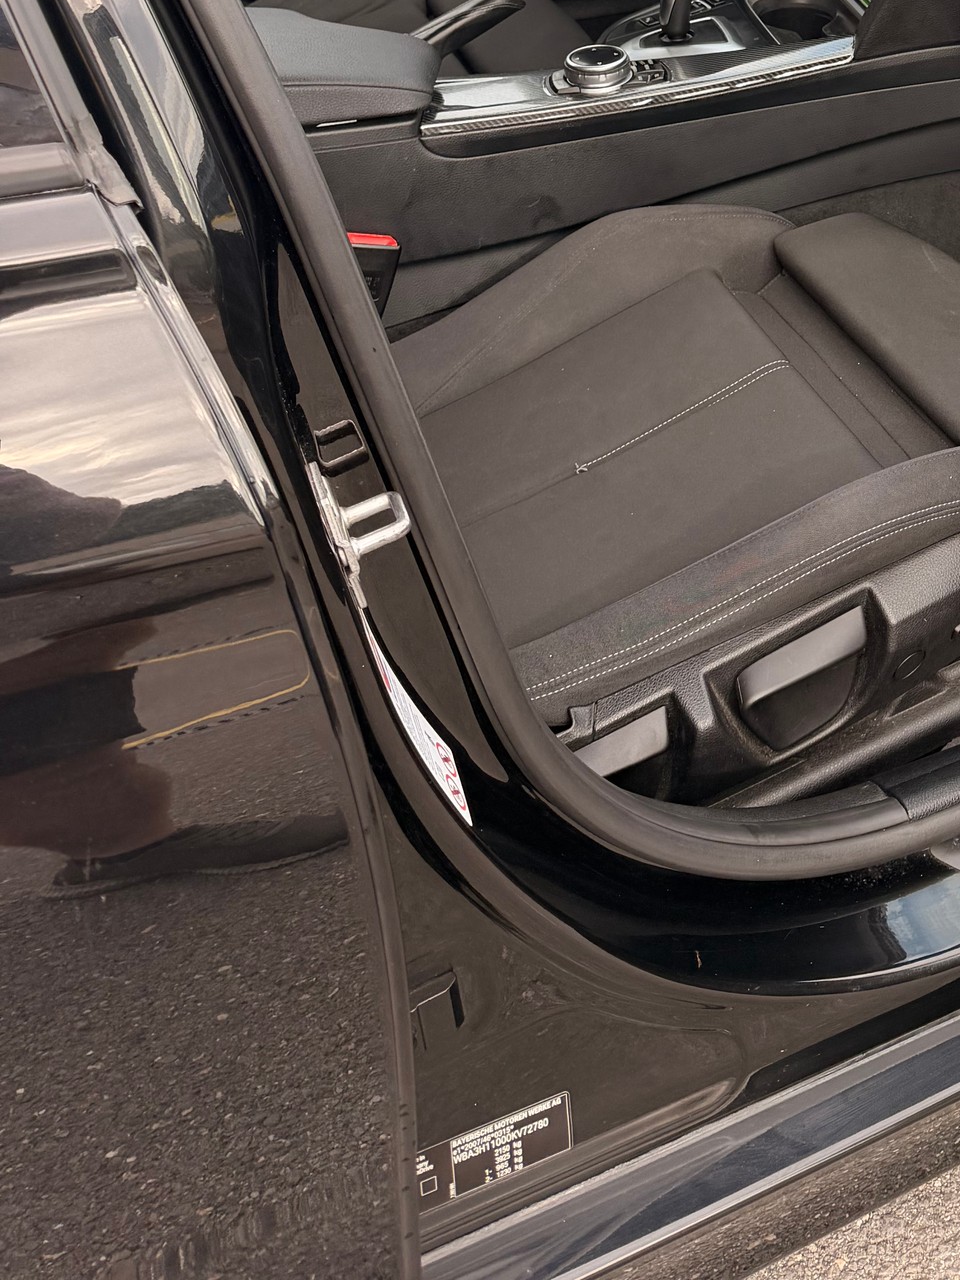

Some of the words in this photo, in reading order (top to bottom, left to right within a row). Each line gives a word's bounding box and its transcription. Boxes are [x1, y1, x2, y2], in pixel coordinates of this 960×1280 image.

[452, 1125, 494, 1148] BAYERISCHE
[494, 1111, 528, 1131] MOTOREN
[528, 1103, 551, 1117] WERKE
[551, 1097, 562, 1107] AG
